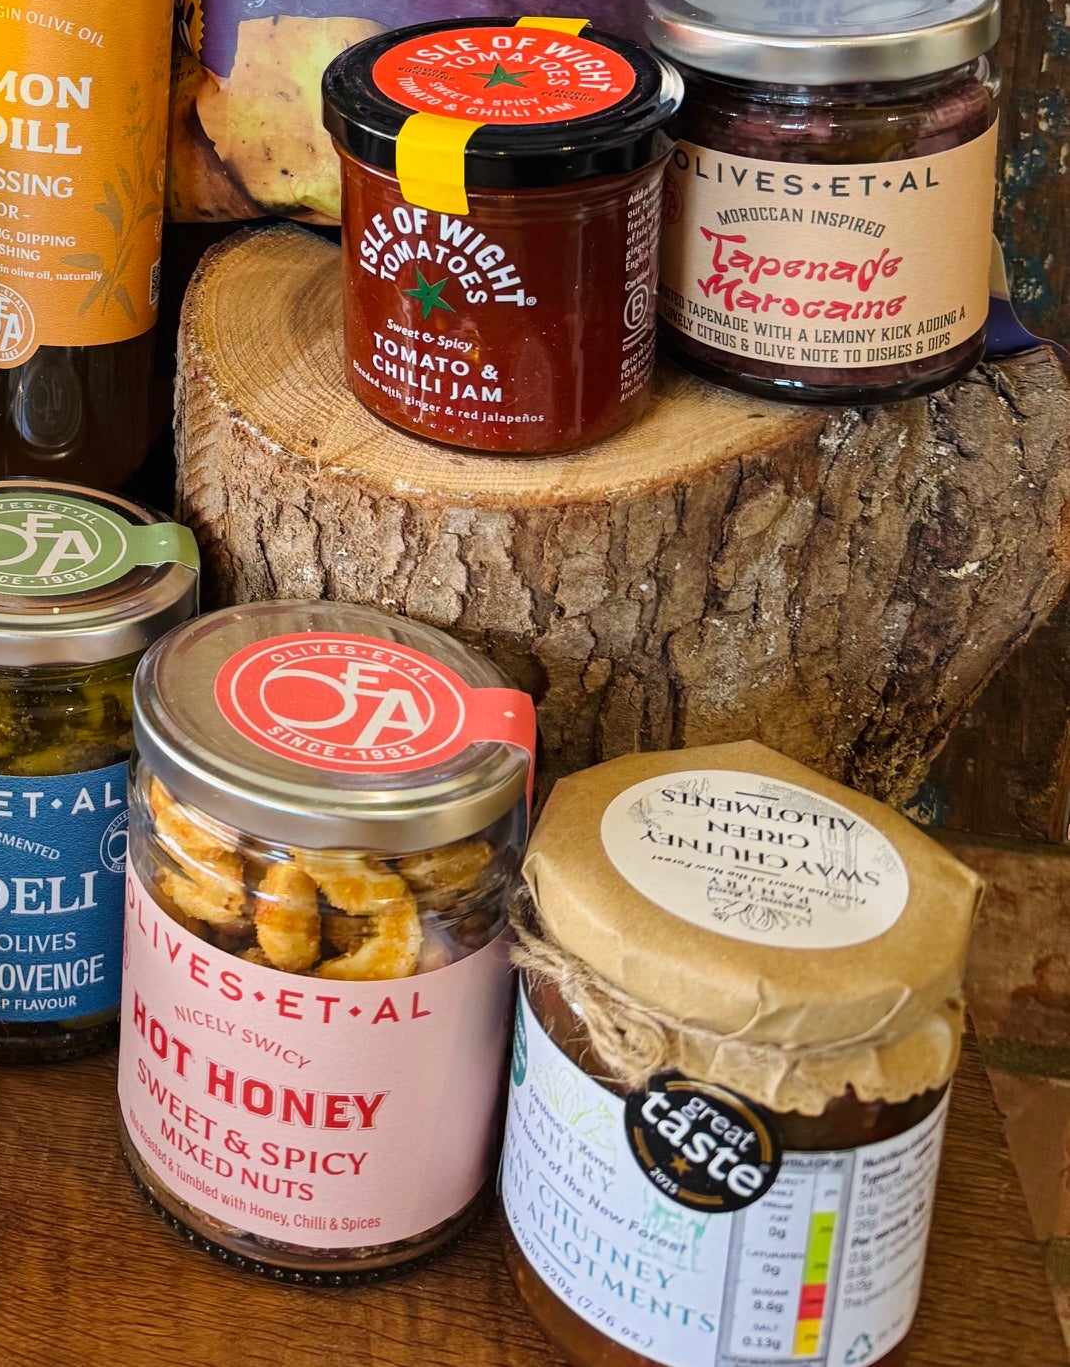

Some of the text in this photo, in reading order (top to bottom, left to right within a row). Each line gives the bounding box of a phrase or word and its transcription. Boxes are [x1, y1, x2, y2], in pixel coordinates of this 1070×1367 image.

[441, 50, 571, 87] TOMATOES
[716, 207, 887, 239] MOROCCAN INSPIRED
[56, 271, 103, 282] naturally
[380, 240, 489, 306] TOMATOES
[700, 227, 904, 292] Tapenade
[697, 273, 908, 323] Marocaine
[386, 318, 474, 354] Sweet Spicy
[687, 300, 875, 344] TAPENADE WITH LEMONY
[697, 323, 912, 363] CITRUS OLIVE DISHES
[372, 332, 470, 377] TOMATO
[372, 355, 503, 403] CHILLI JAM
[481, 411, 545, 424] jalapeños
[267, 725, 417, 763] SINCE 1993
[660, 788, 858, 833] ALLOTMENTS
[706, 819, 810, 851] GREEN
[640, 829, 881, 887] SWAY CHUTNEY
[15, 994, 78, 1011] FLAVOUR
[174, 1003, 312, 1070] NICELY SWICY
[133, 989, 392, 1132] HOT HONEY
[137, 1058, 369, 1176] SWEET SPICY
[683, 1095, 759, 1152] great
[161, 1118, 314, 1202] MIXED NUTS
[641, 1088, 766, 1199] taste
[649, 1165, 679, 1195] 2025
[341, 1214, 381, 1231] Spices
[538, 1181, 677, 1292] CHUTNEY
[526, 1199, 717, 1334] ALLOTMENTS
